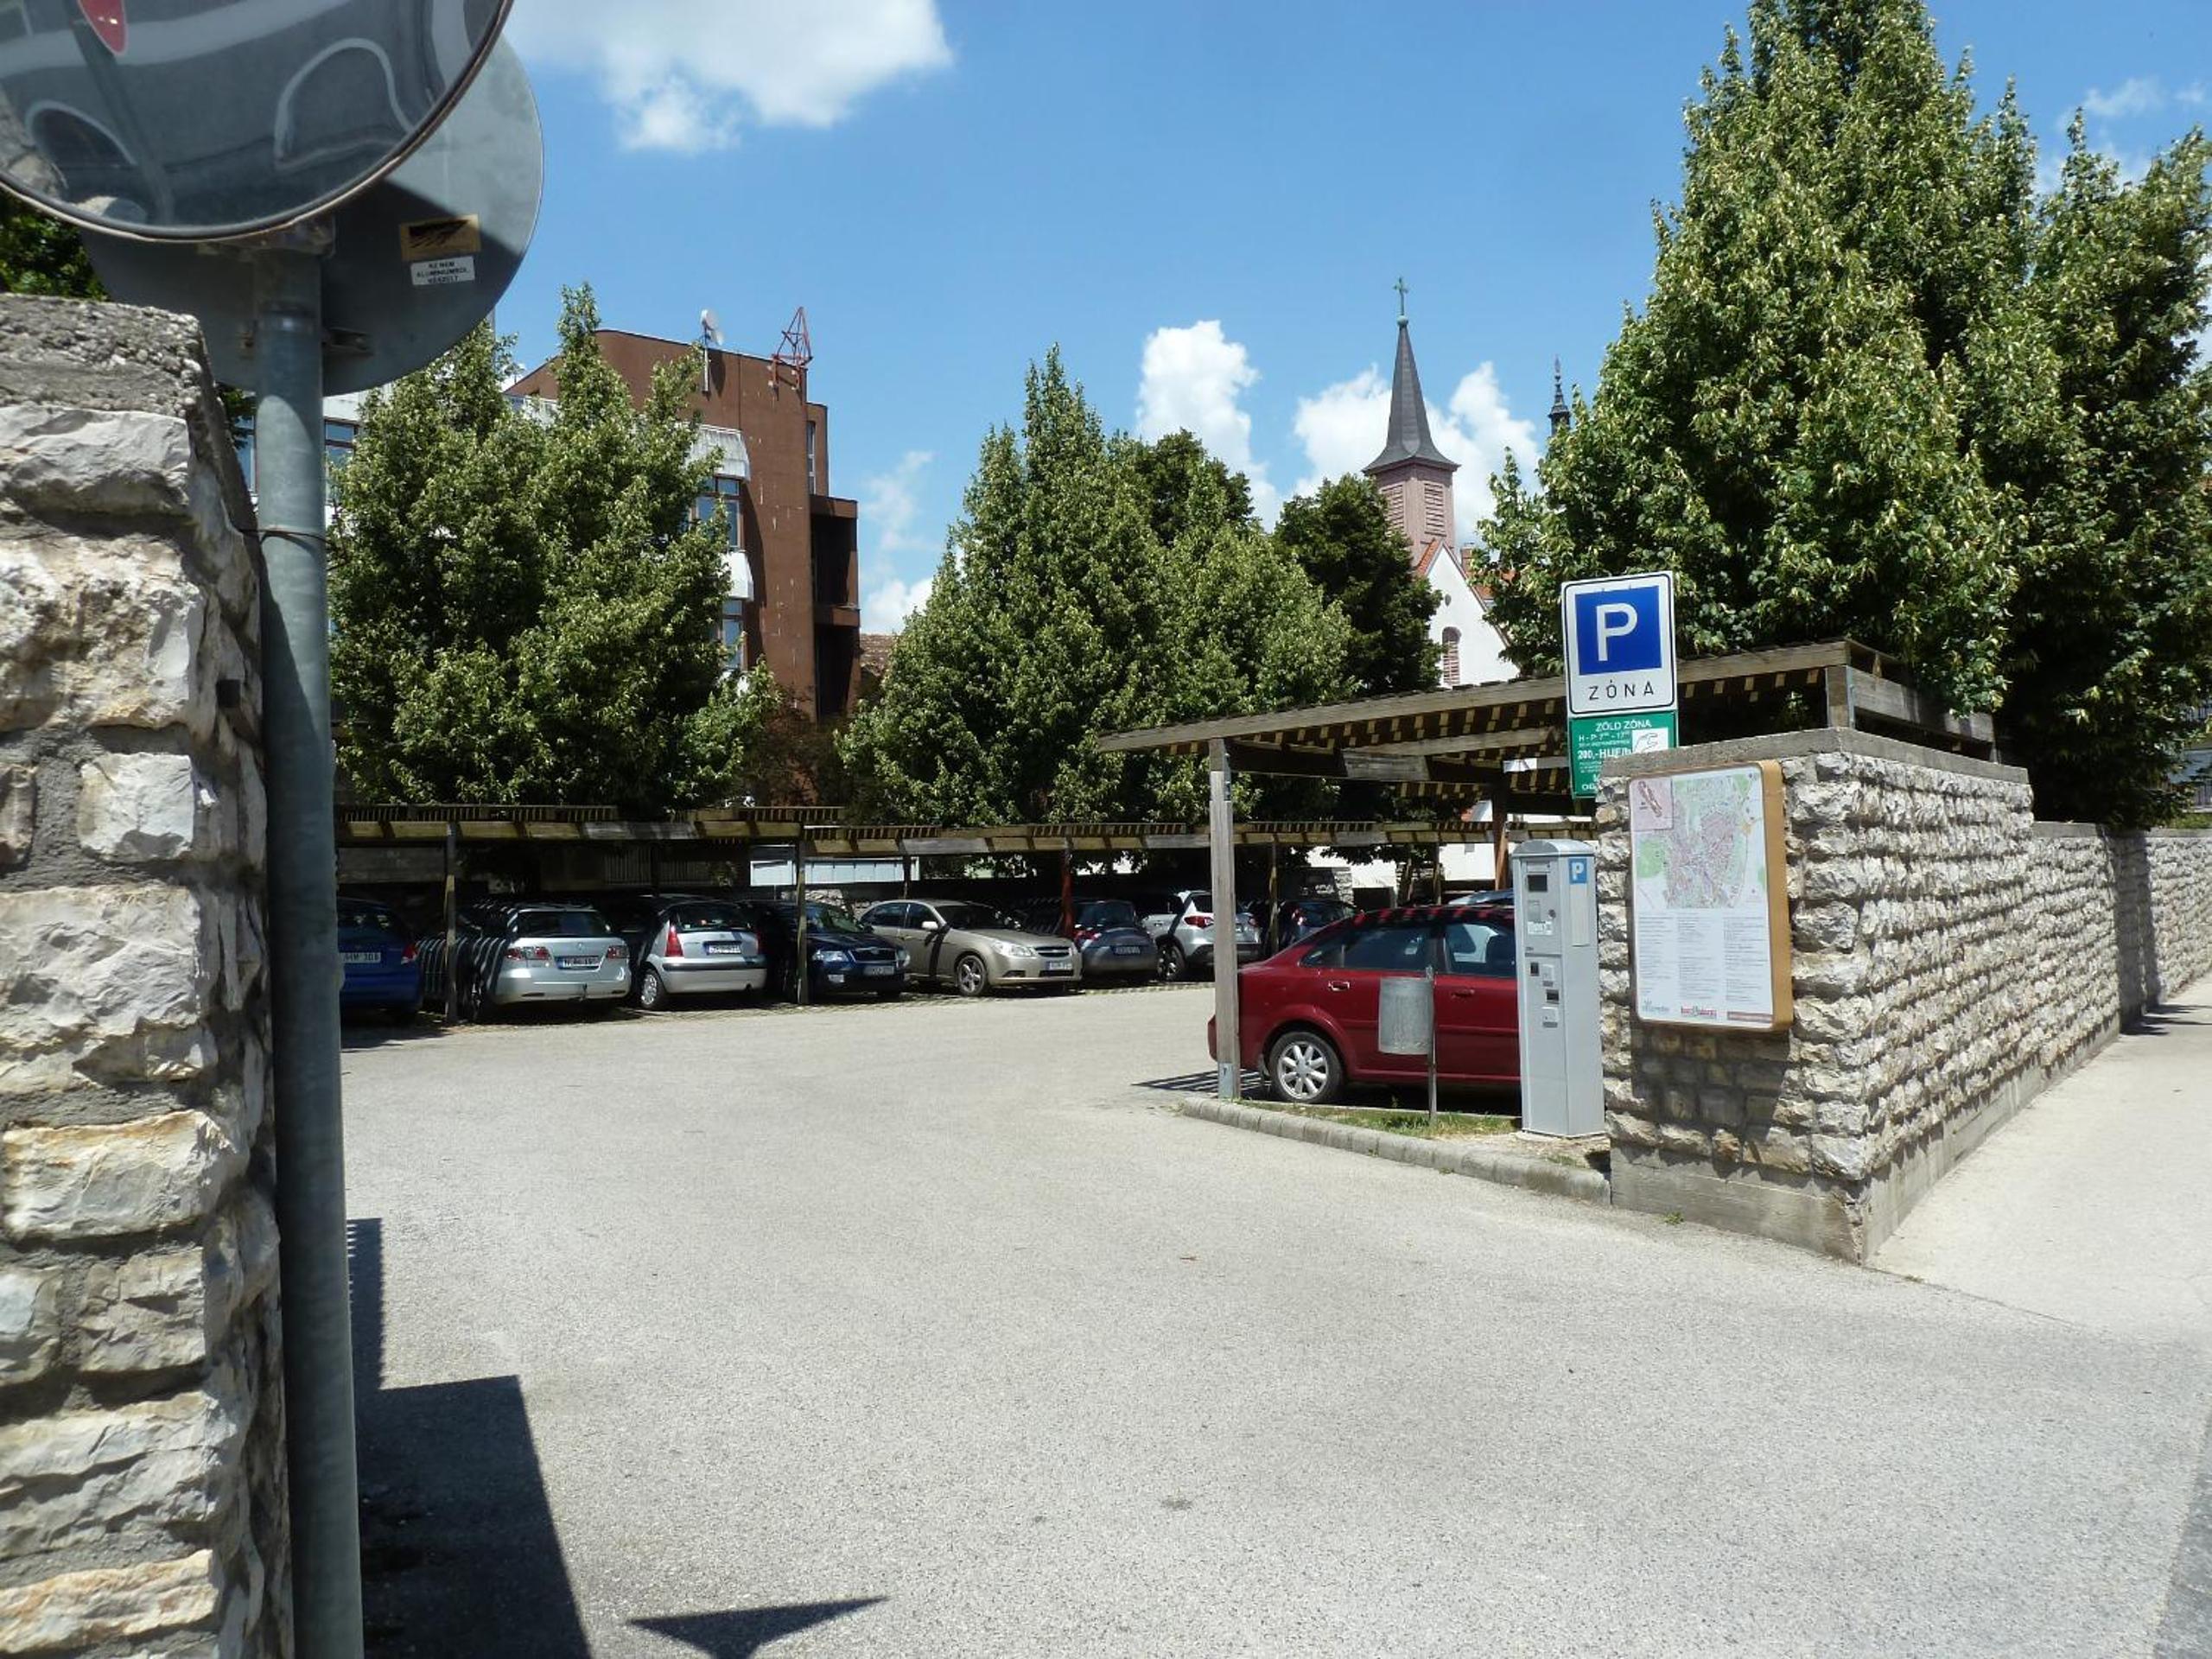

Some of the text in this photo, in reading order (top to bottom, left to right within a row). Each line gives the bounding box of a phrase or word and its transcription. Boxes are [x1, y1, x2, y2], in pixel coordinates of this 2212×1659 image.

[1596, 602, 1638, 662] P
[1588, 679, 1655, 701] ZÓNA
[1624, 719, 1652, 730] ZÓNA
[1572, 861, 1585, 881] P
